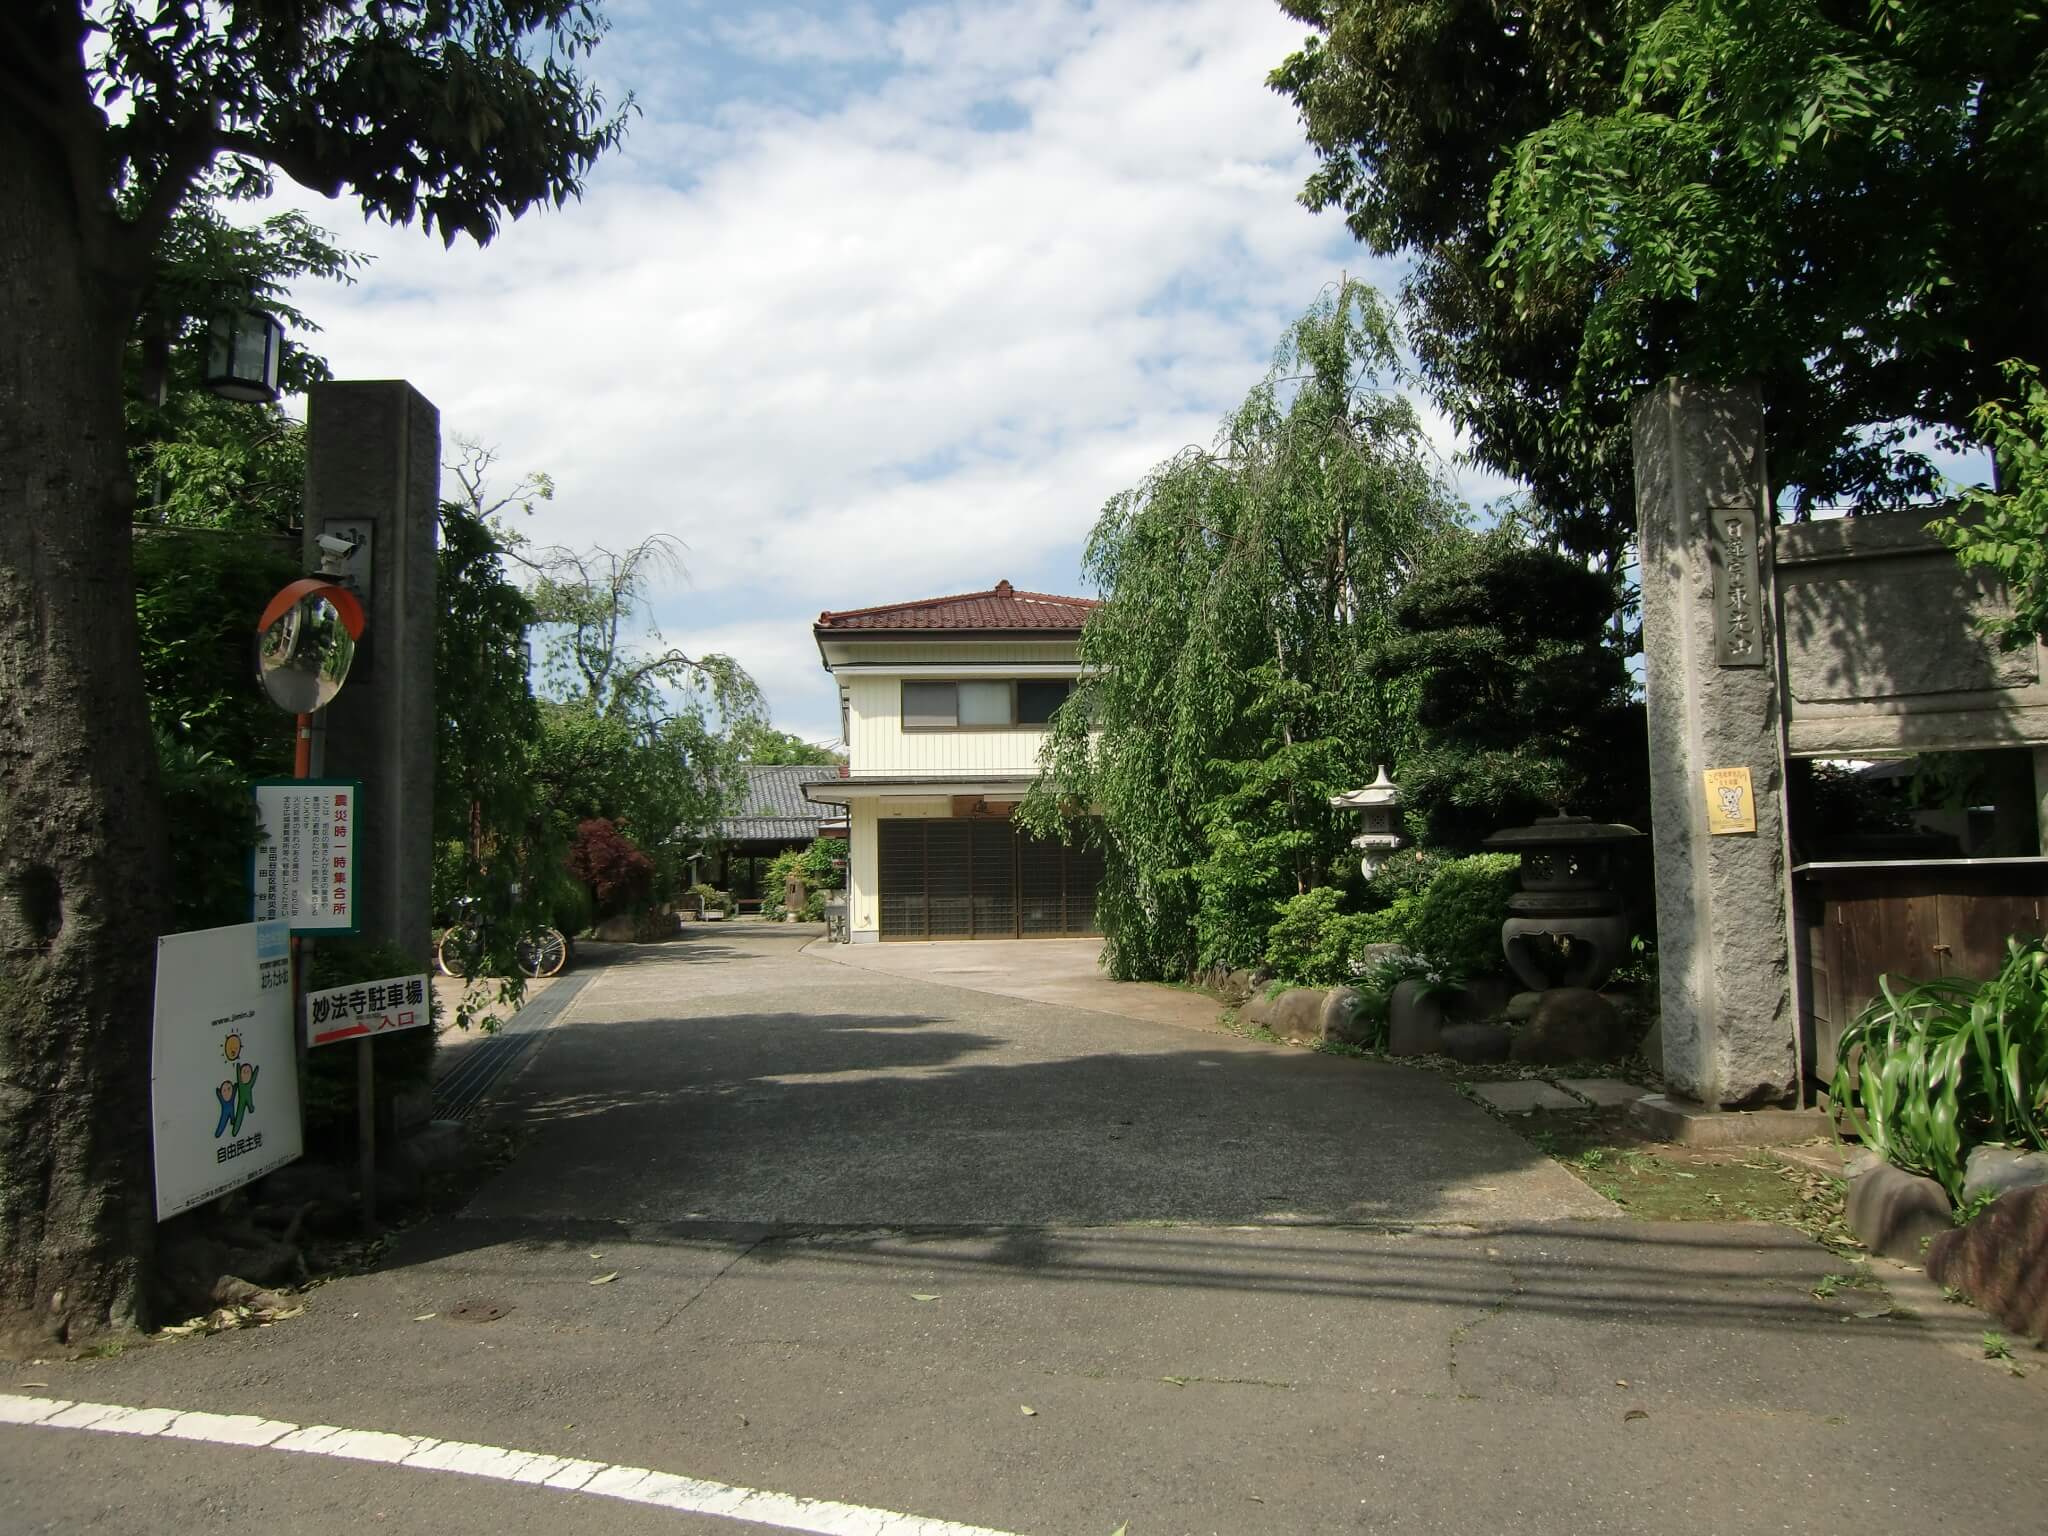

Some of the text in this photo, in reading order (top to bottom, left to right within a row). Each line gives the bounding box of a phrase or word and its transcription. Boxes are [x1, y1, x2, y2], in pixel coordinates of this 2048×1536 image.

[1724, 517, 1755, 656] 日蓮宗東光山
[332, 794, 348, 915] 震災時一時集合所
[312, 980, 423, 1025] 妙法寺駐車場
[378, 1011, 415, 1030] 入口
[216, 1131, 263, 1164] 自由民主党
